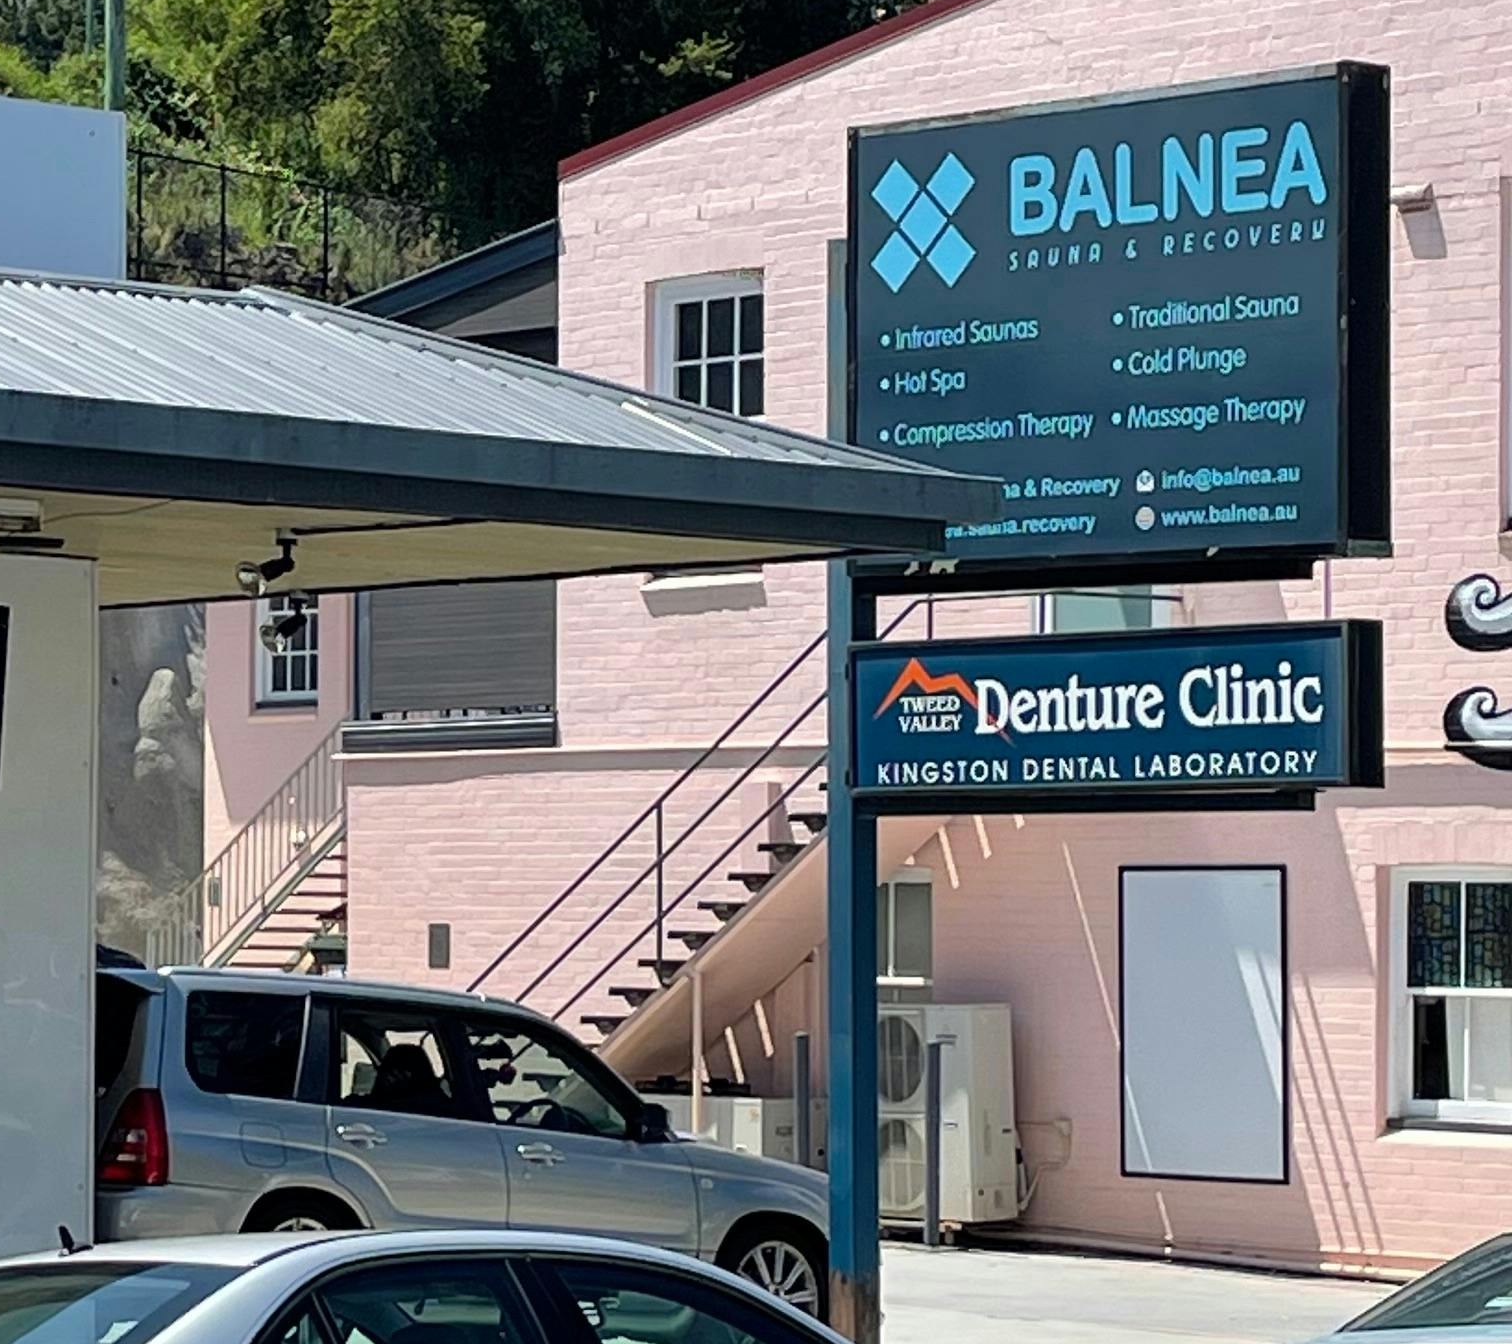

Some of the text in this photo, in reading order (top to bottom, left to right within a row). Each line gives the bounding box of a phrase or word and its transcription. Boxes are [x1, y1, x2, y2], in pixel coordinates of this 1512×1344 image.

[1010, 120, 1327, 237] BALNEA
[1008, 218, 1326, 272] SAUNA & RECOVERY
[1128, 294, 1300, 329] Traditional Sauna
[894, 319, 1038, 351] Infrared Saunas
[1128, 345, 1248, 375] Cold Plunge
[894, 368, 966, 397] Hot Spa
[1127, 396, 1306, 432] Massage Therapy
[894, 413, 1094, 449] Compression Therapy
[1023, 479, 1037, 498] &
[1040, 476, 1122, 498] Recovery
[1161, 465, 1301, 493] info@balnea.au
[1160, 503, 1298, 528] www.balnea.au
[898, 695, 961, 714] TWEED
[973, 660, 1324, 736] Denture Clinic
[898, 714, 963, 734] VALLEY
[877, 749, 1318, 785] KINGSTON DENTAL LABORATORY
